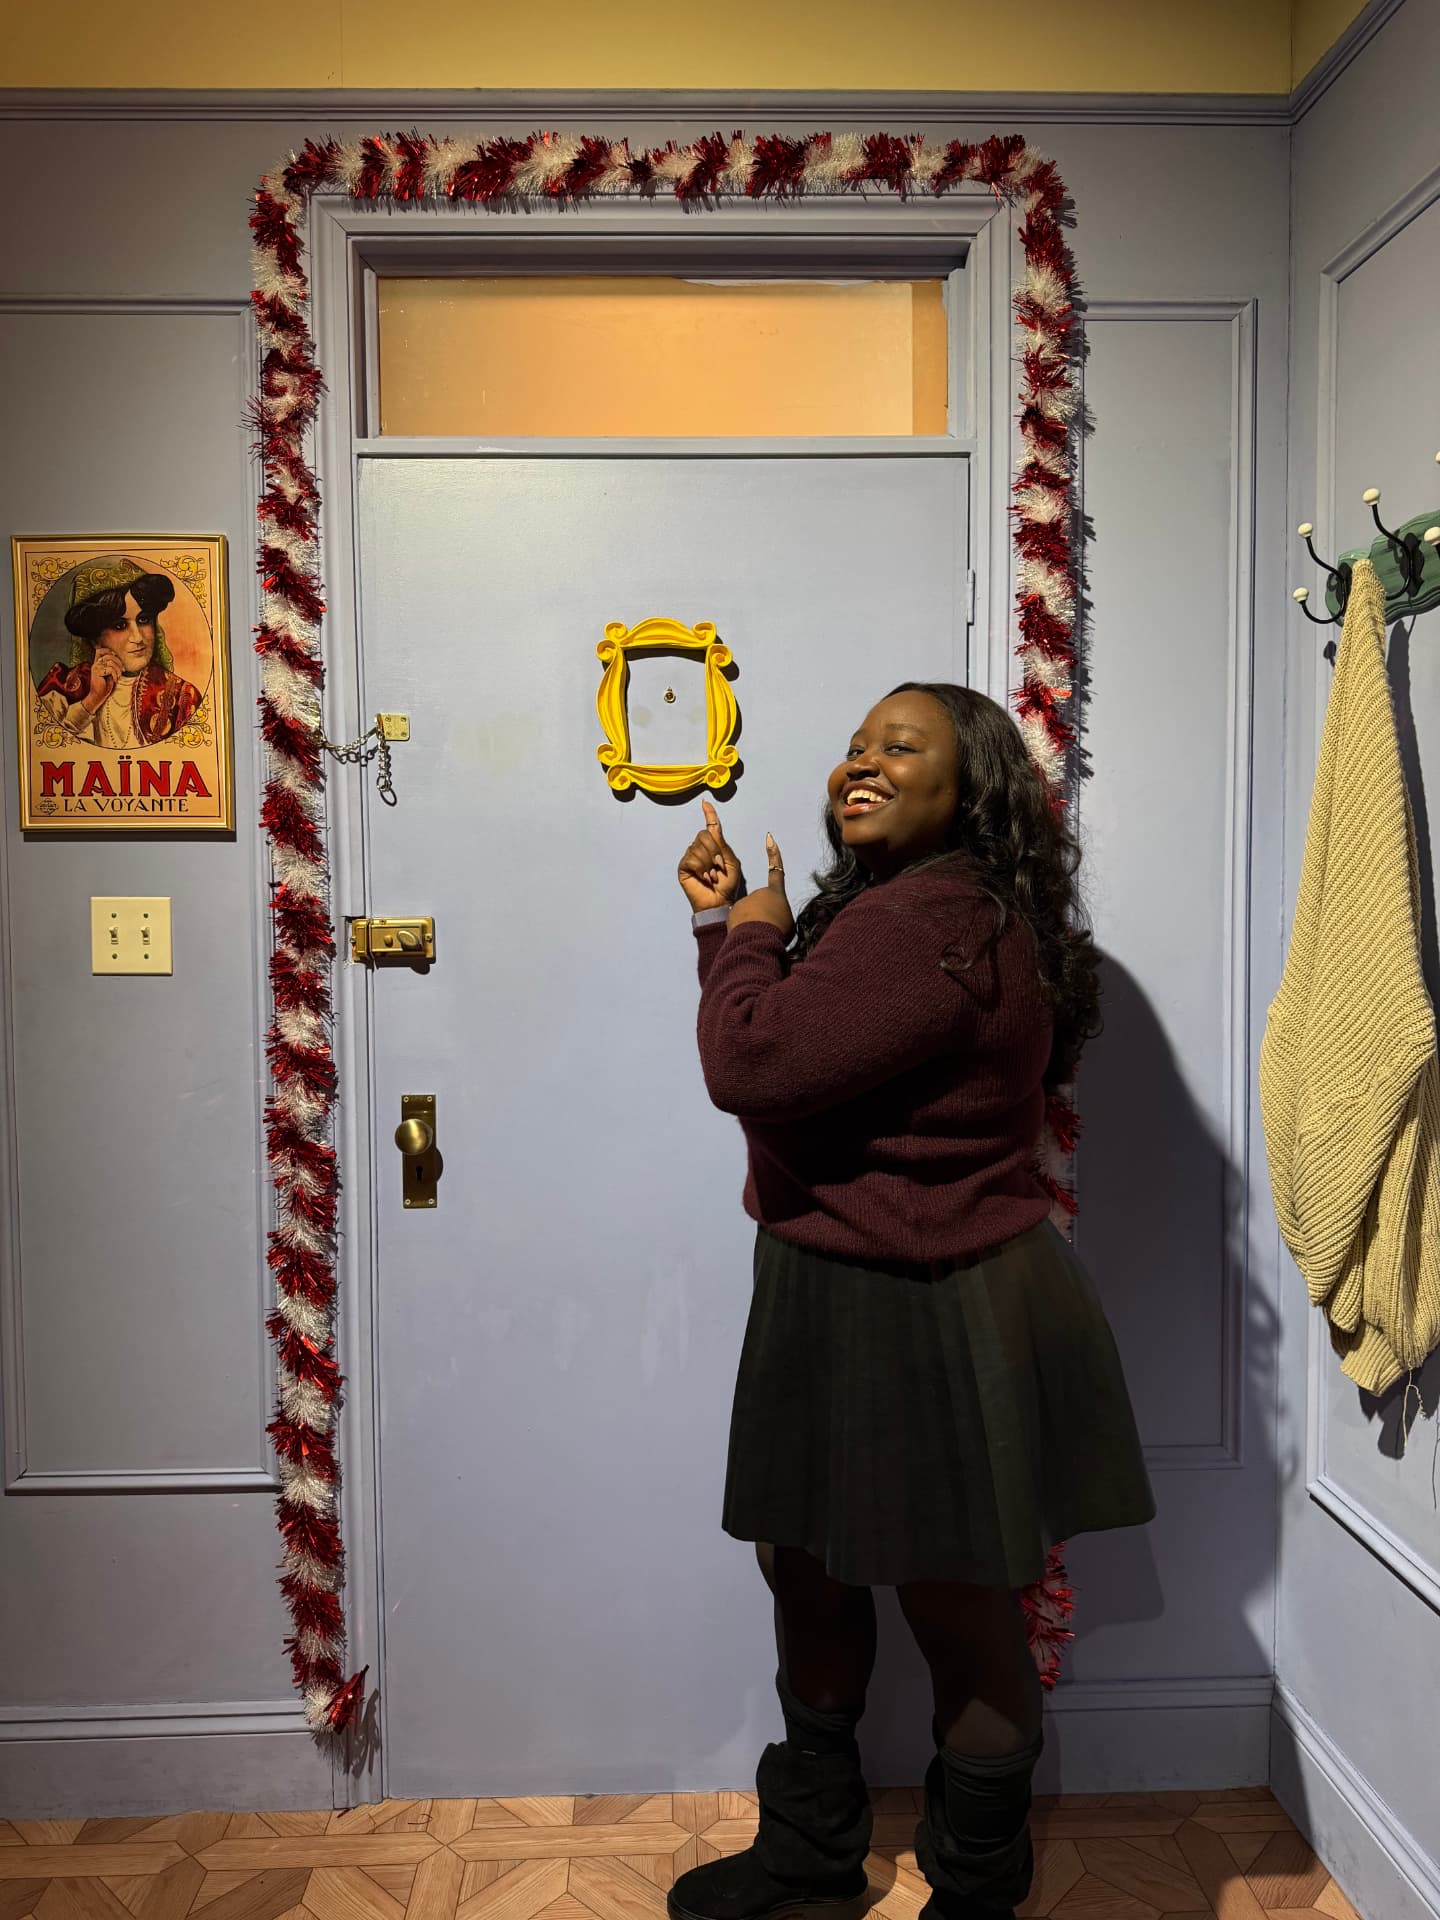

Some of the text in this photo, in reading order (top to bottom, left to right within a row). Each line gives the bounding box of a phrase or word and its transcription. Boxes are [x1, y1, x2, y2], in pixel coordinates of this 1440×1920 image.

[40, 755, 212, 797] MAÏNA
[64, 799, 87, 812] LA
[94, 798, 189, 812] VOYANTE
